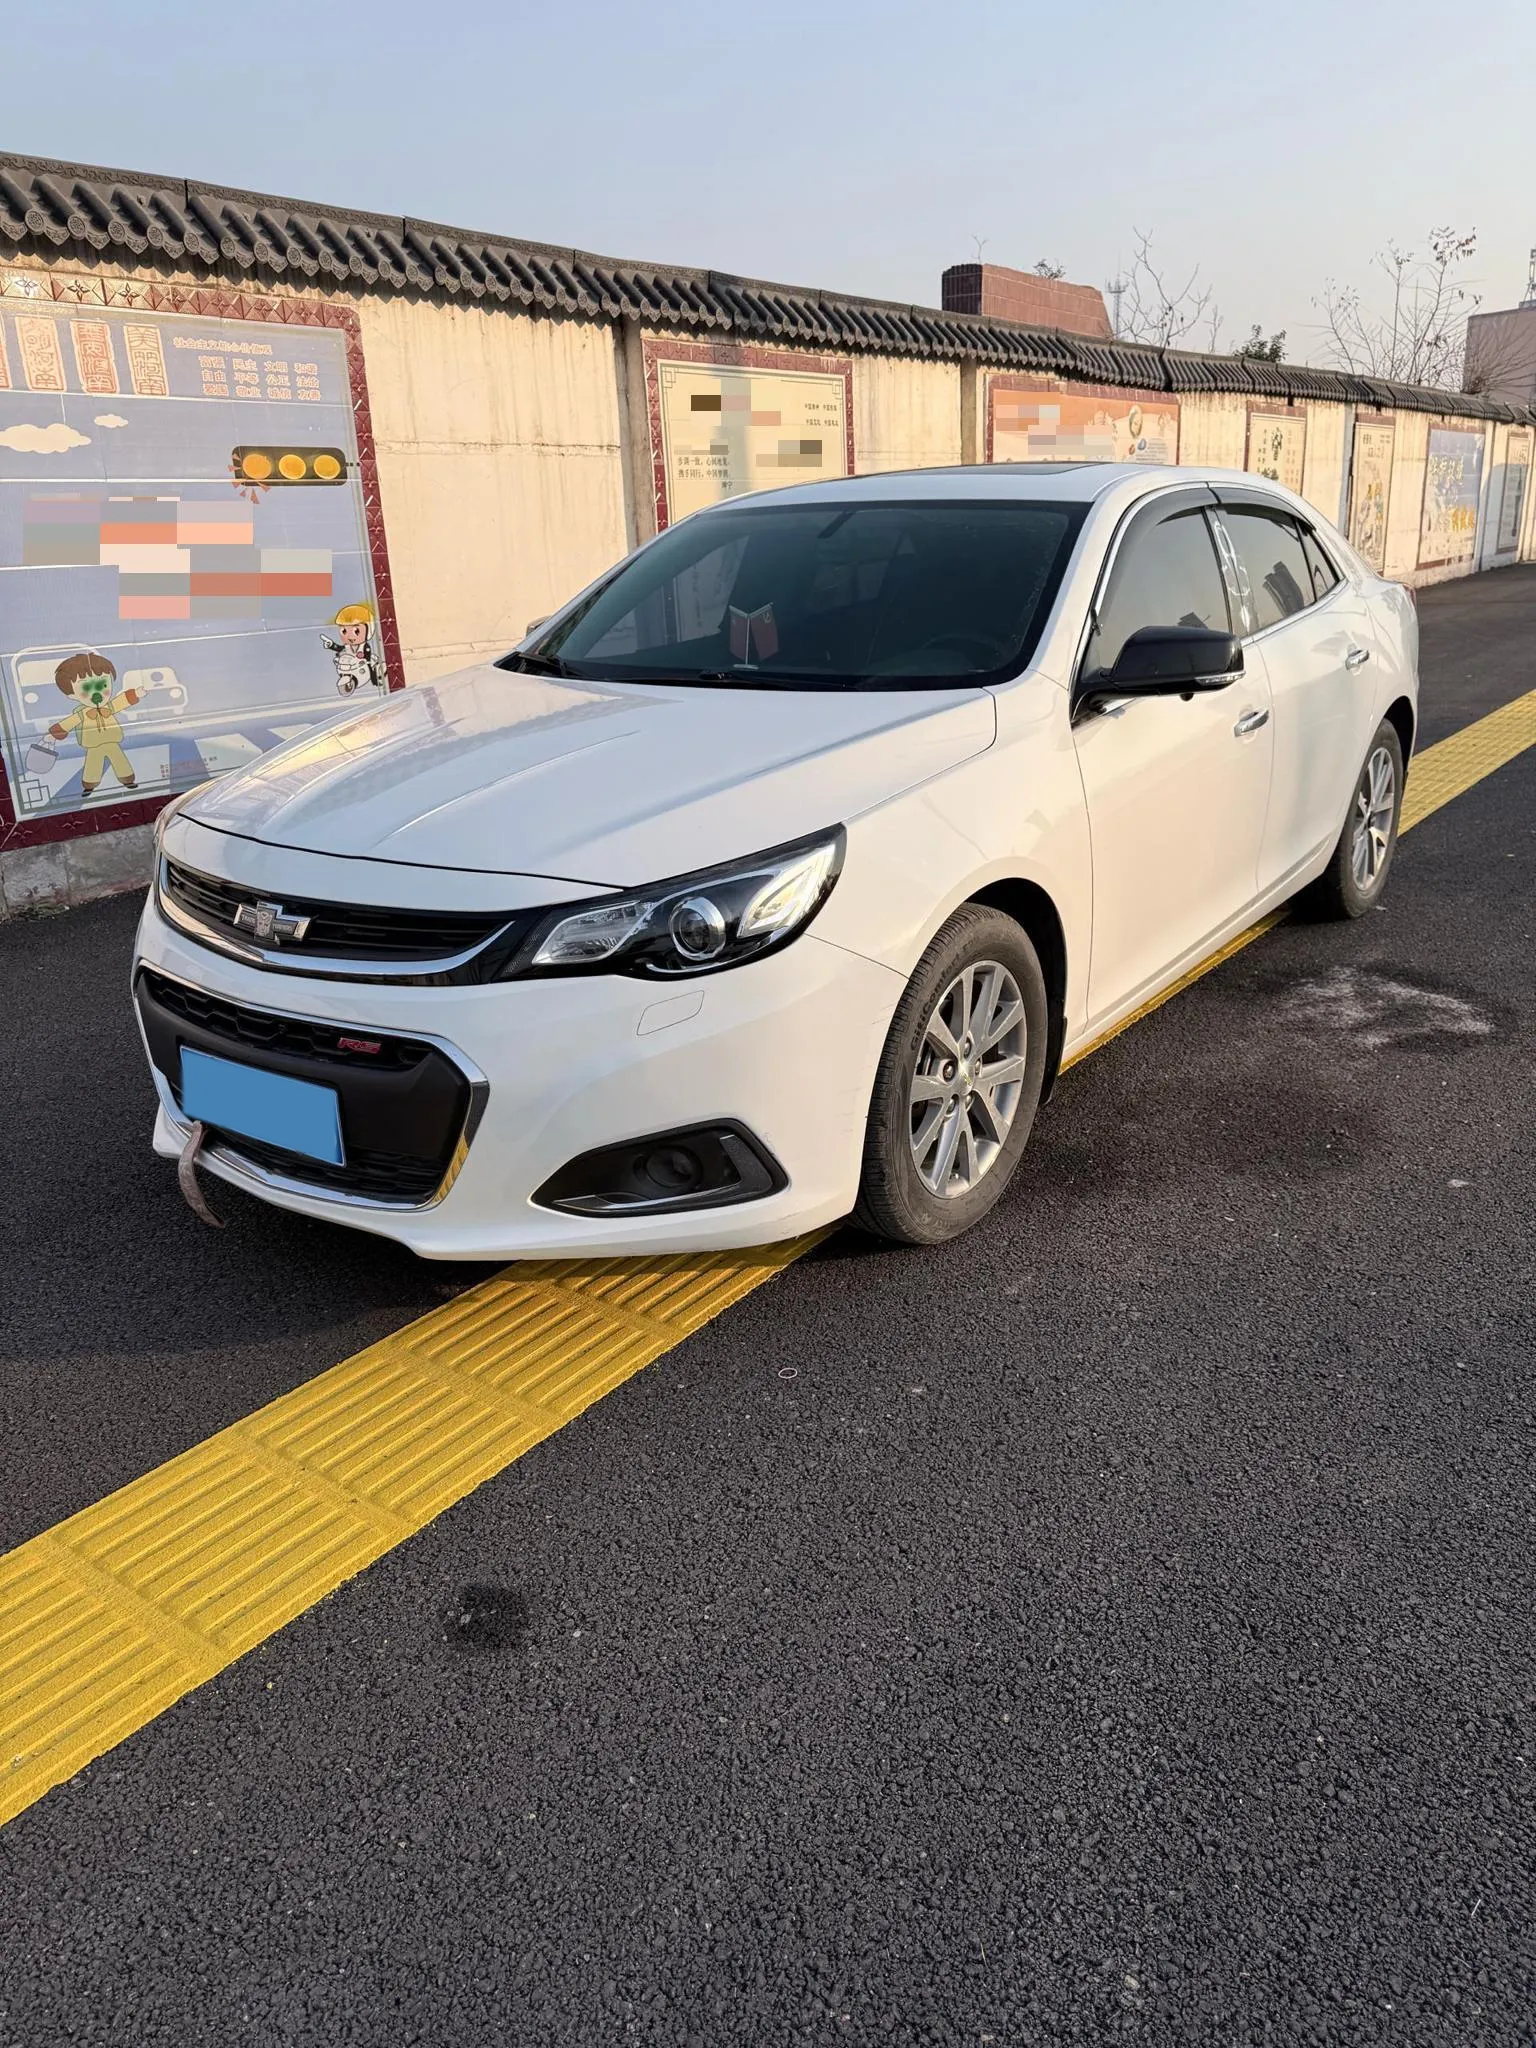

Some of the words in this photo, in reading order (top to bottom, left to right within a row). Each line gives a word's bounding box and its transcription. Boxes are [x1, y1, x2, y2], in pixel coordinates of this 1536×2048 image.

[263, 360, 289, 373] 文明
[201, 369, 226, 382] 自由
[265, 373, 291, 387] 公正
